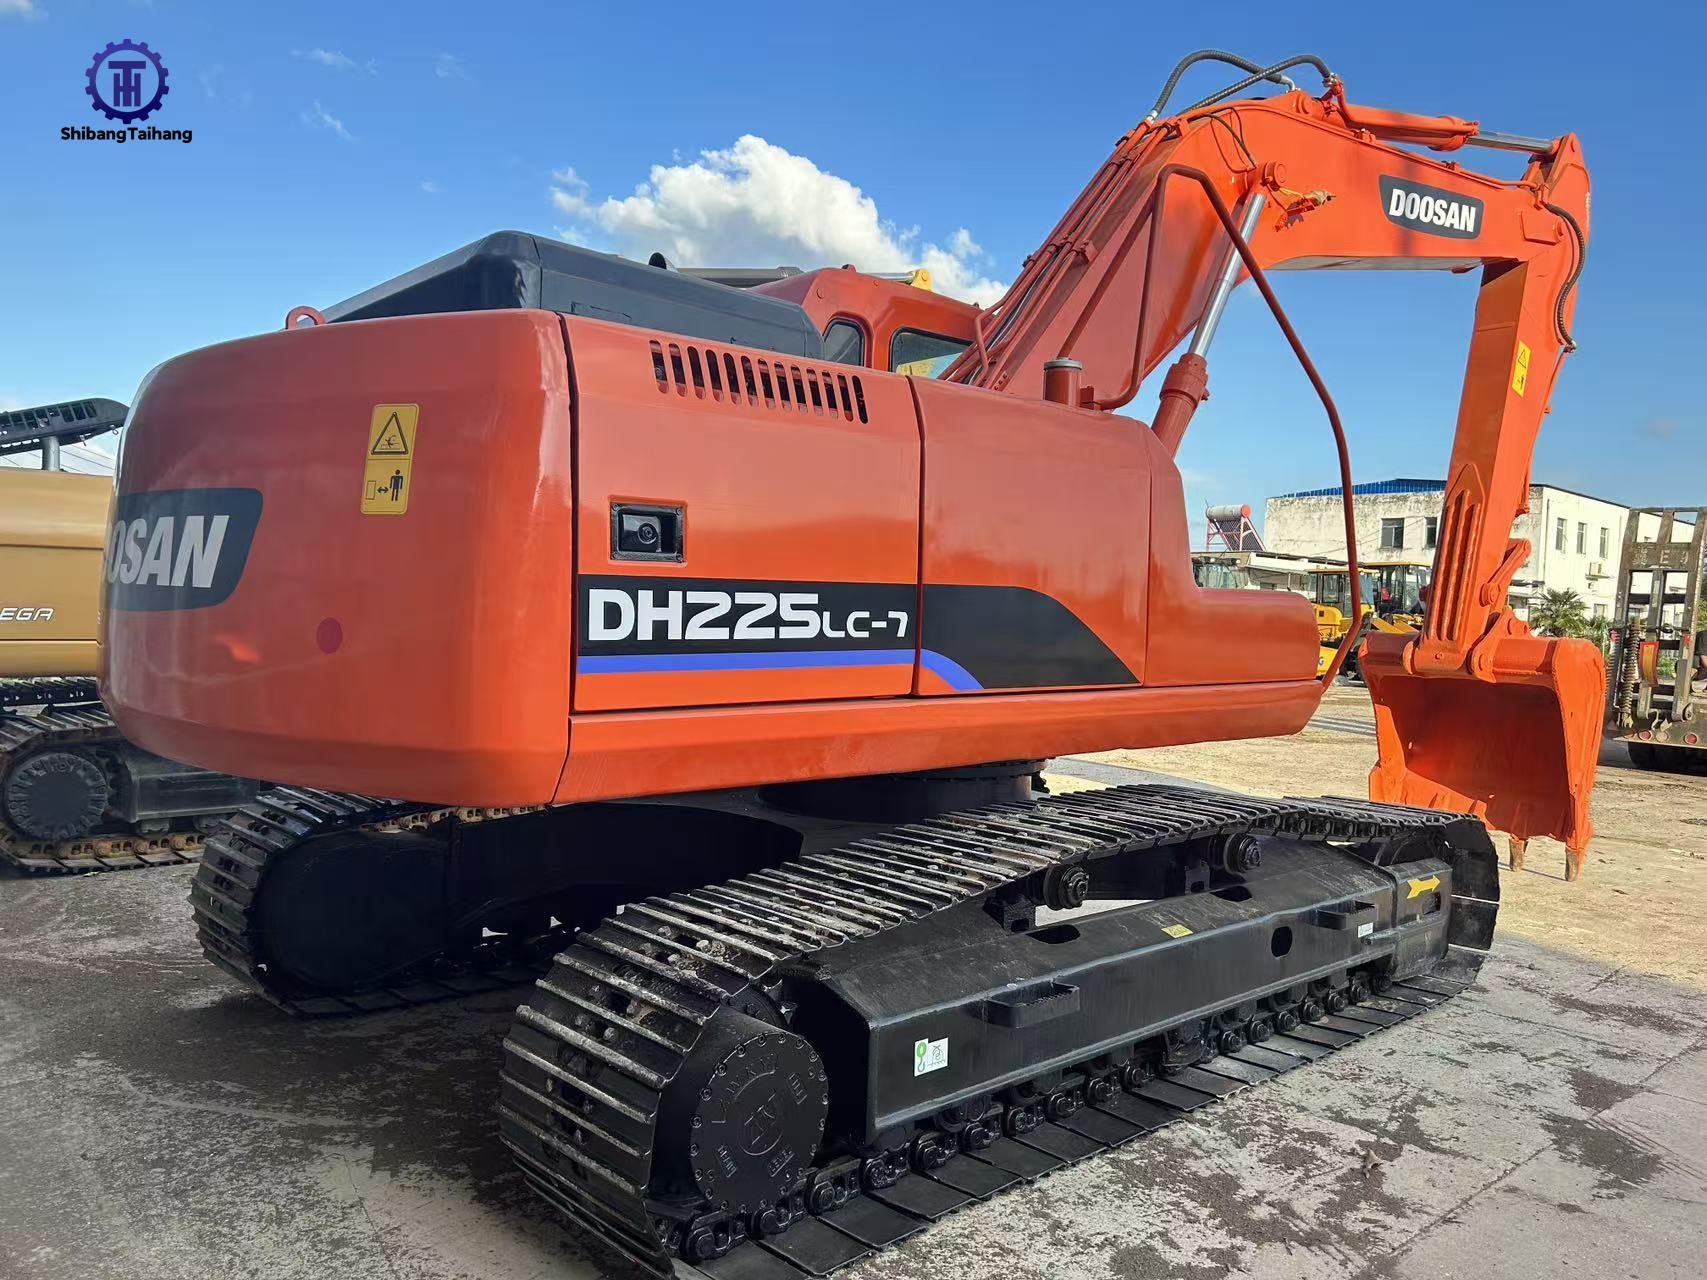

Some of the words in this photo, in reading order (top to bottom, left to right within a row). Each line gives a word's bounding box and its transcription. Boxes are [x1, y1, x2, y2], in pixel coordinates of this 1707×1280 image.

[1388, 188, 1477, 233] DOOSAN
[106, 515, 230, 588] OSAN
[588, 588, 909, 641] DH225LC-7
